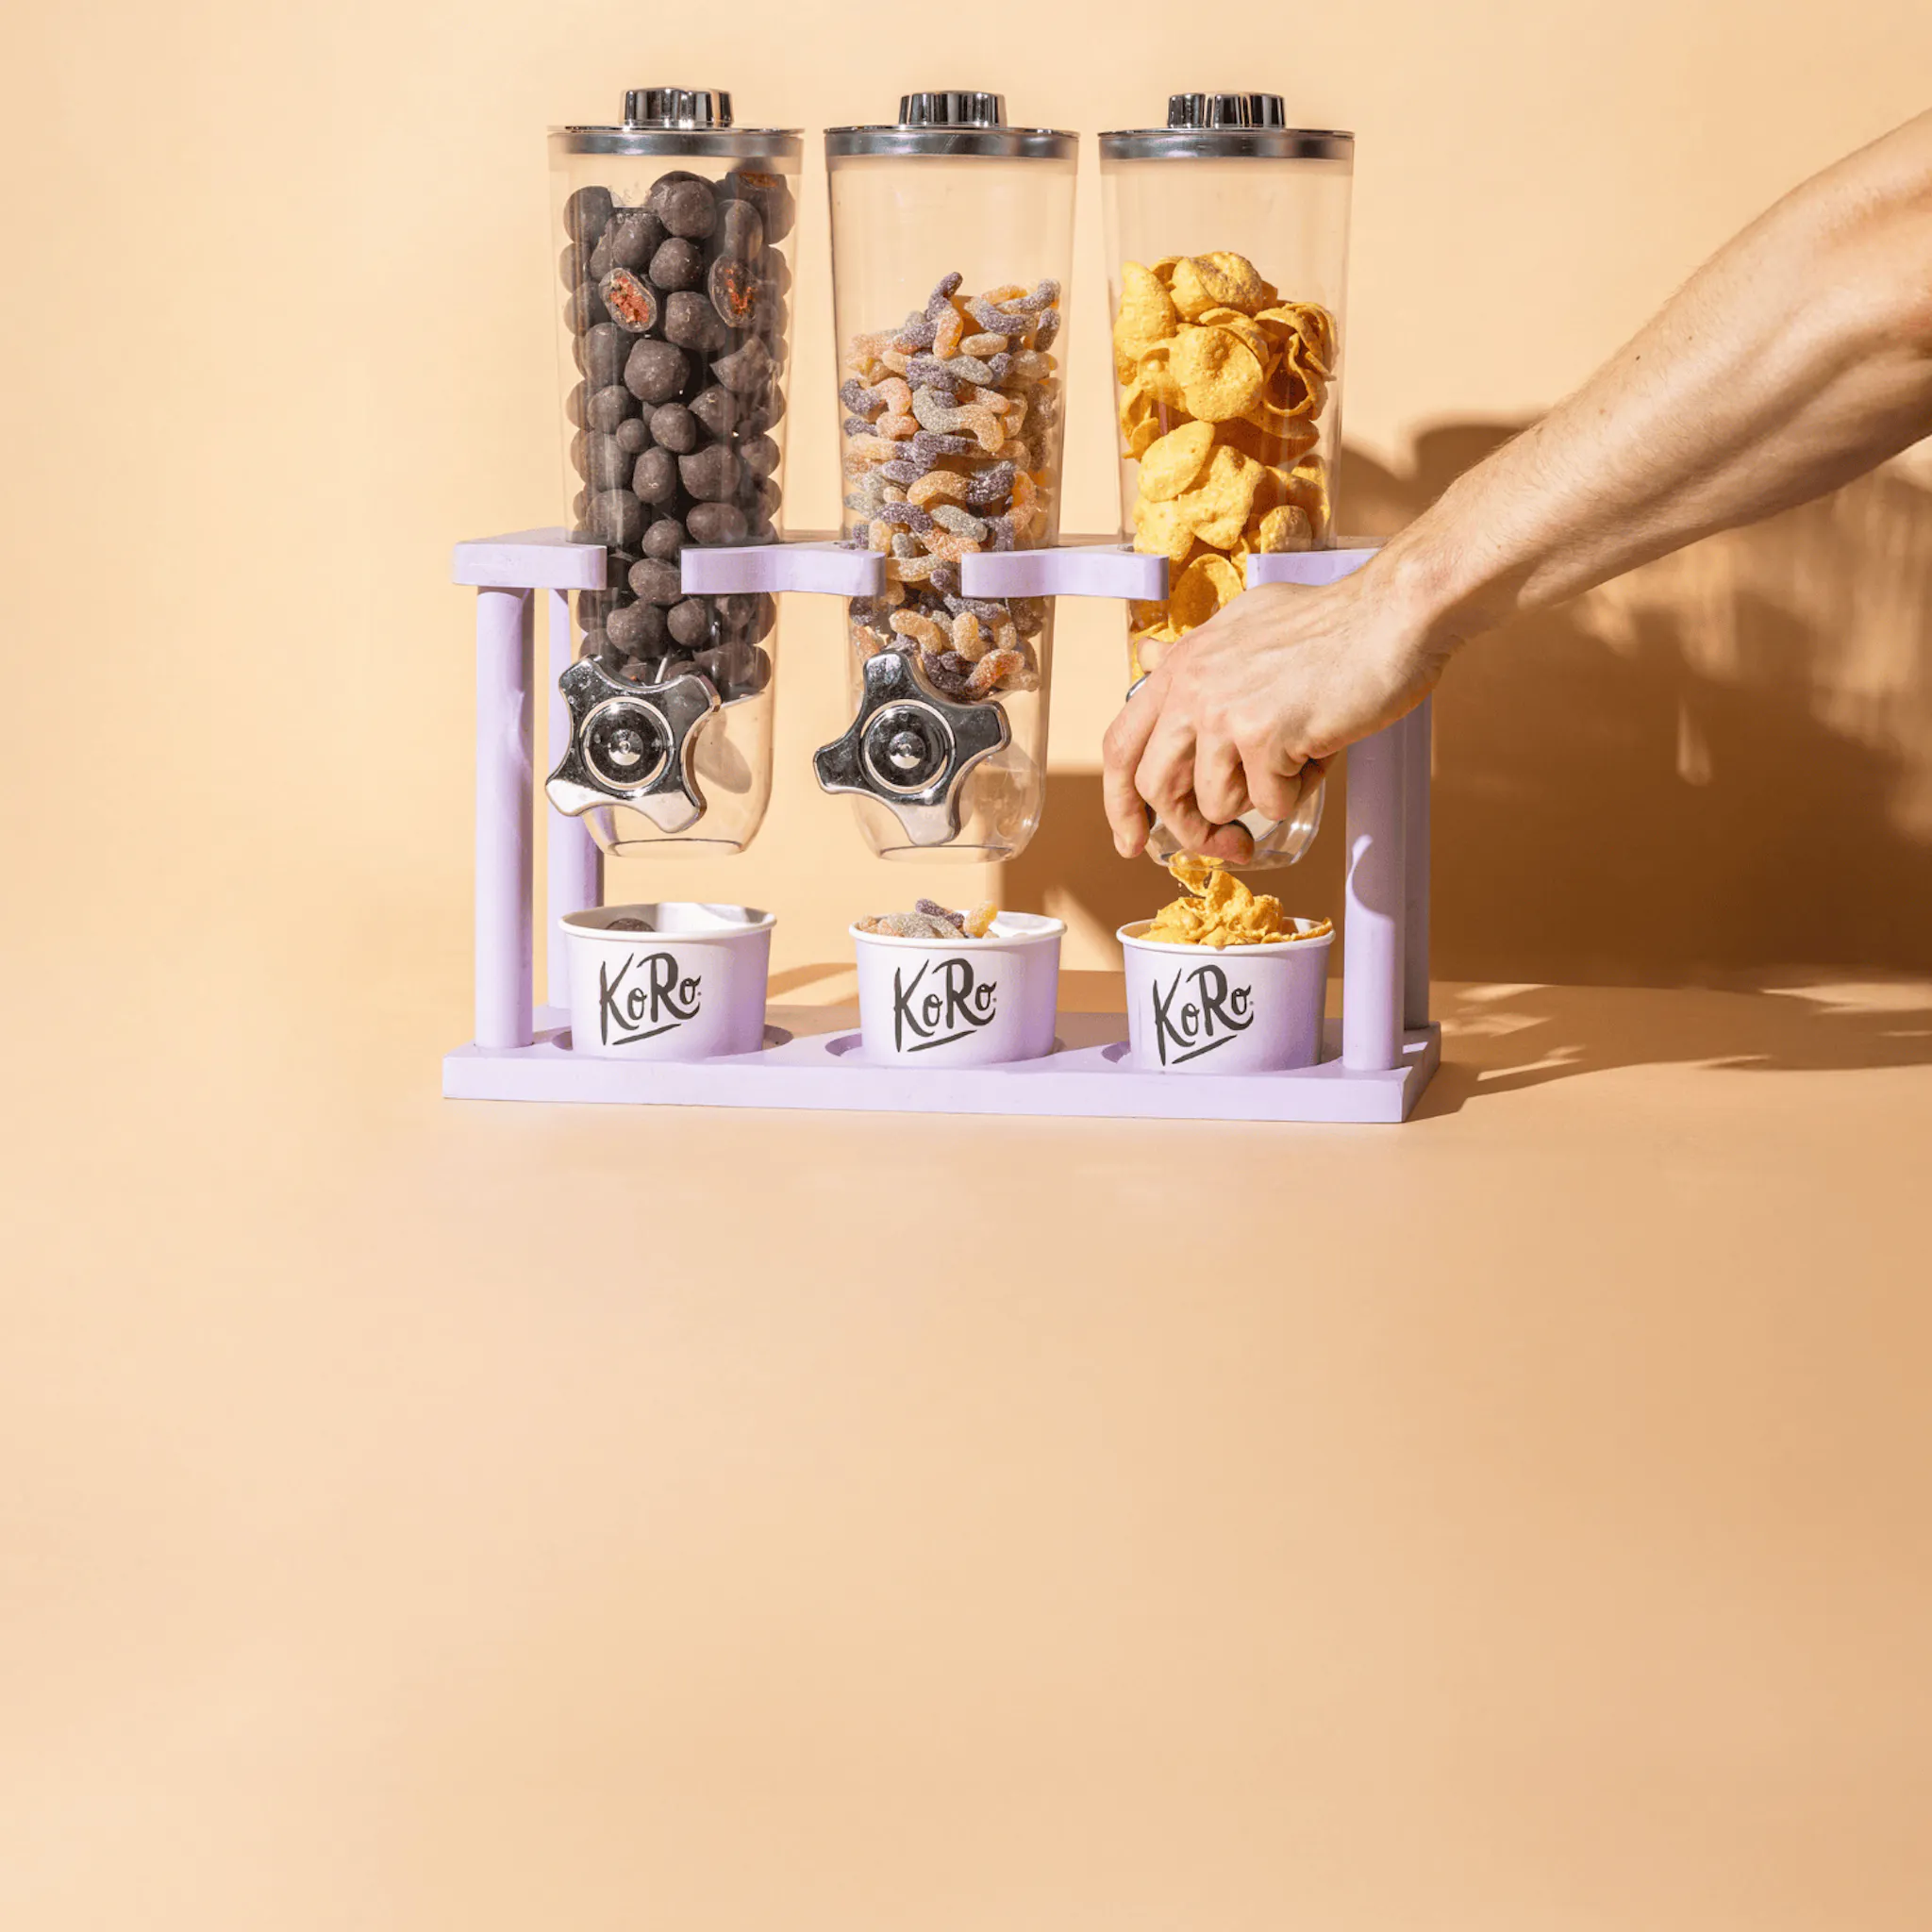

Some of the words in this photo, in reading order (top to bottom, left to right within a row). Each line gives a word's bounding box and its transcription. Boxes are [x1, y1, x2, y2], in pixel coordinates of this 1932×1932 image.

[599, 953, 702, 1046] KoRo
[893, 958, 997, 1053] KoRo
[1153, 964, 1254, 1066] KoRo
